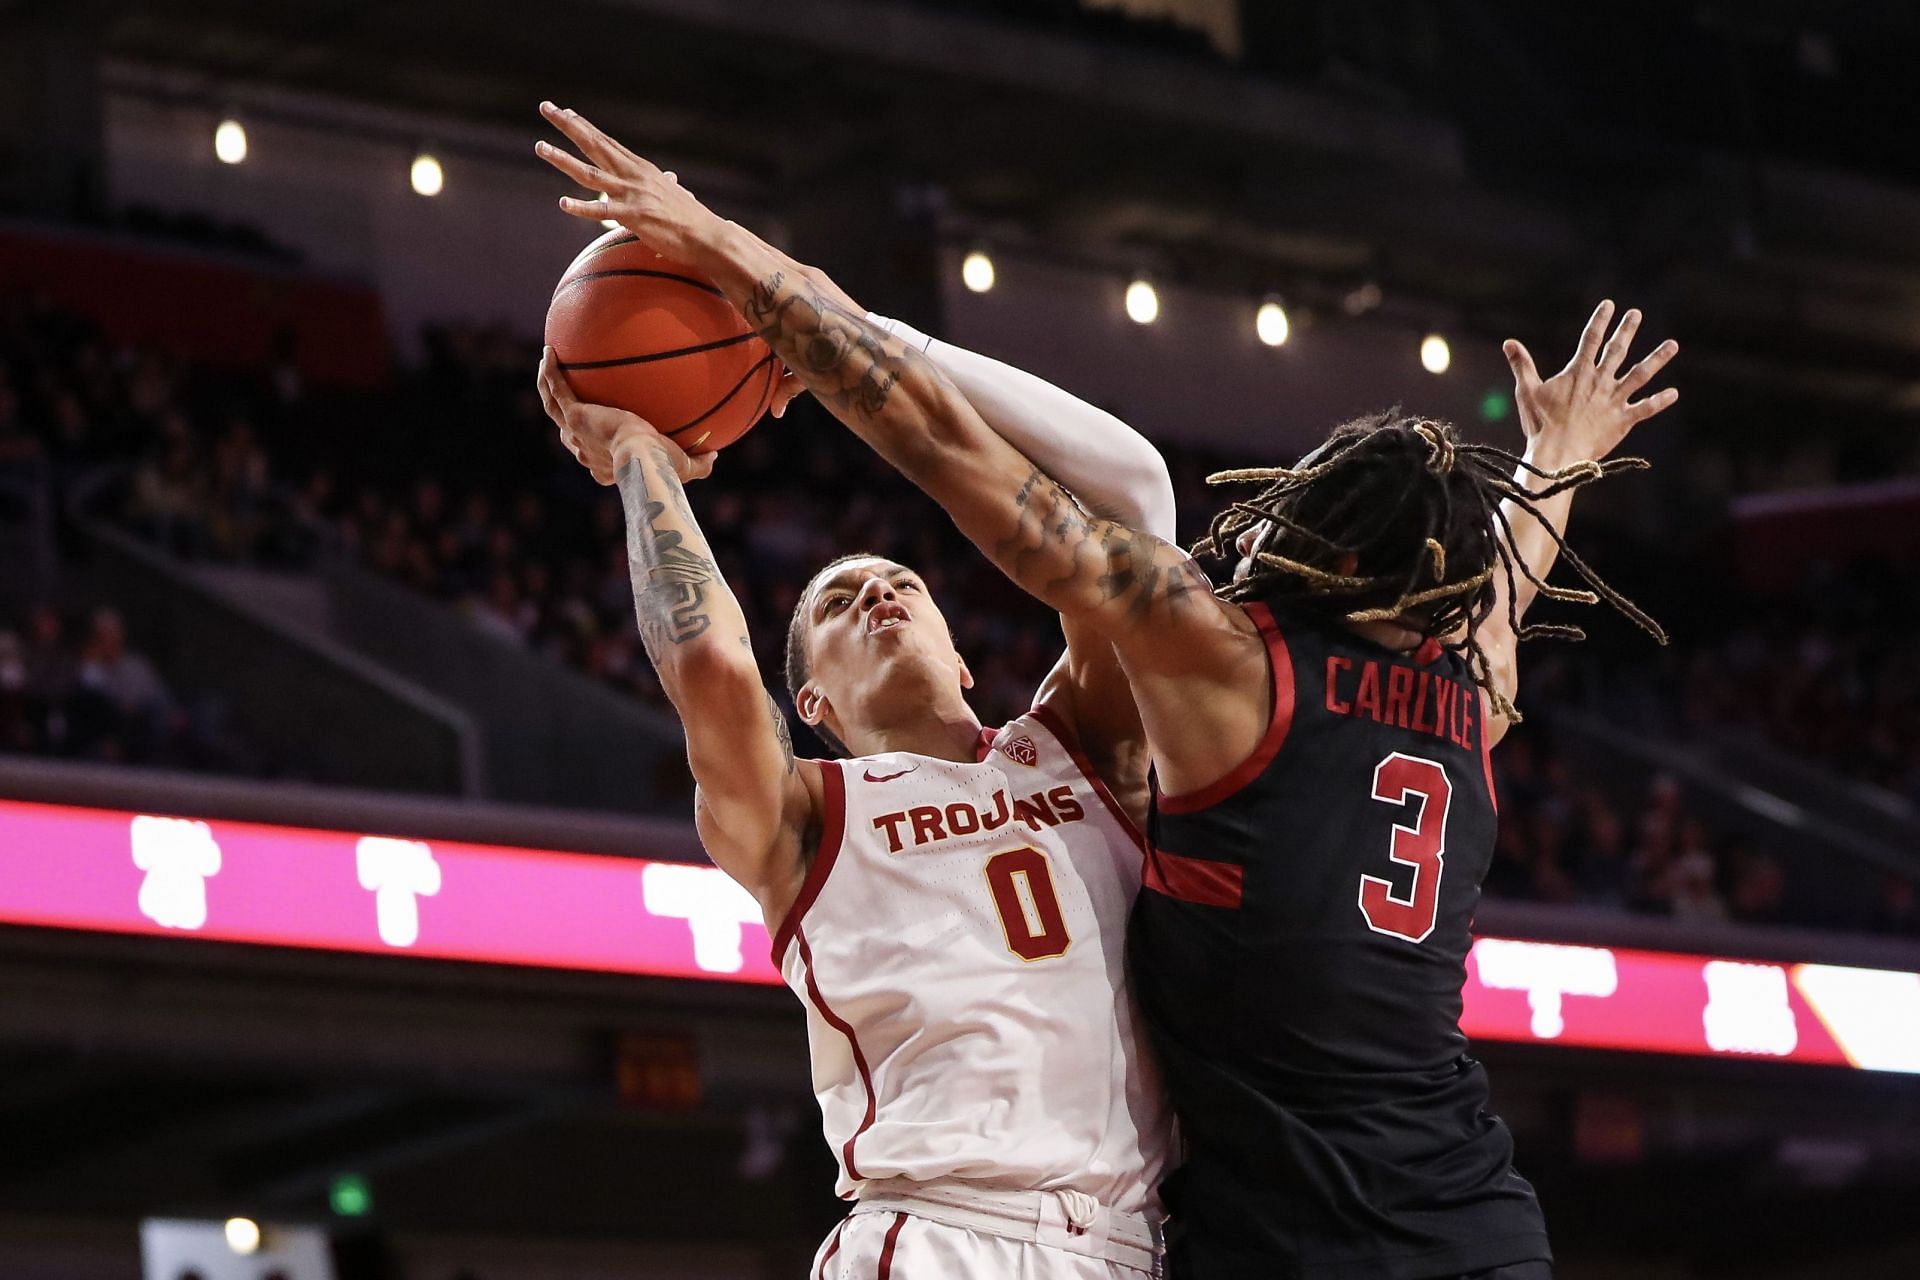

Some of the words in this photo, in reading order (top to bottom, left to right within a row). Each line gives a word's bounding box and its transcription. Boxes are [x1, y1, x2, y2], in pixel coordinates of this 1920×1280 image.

[1324, 655, 1473, 750] CARLYLE
[873, 785, 1086, 854] TROJNS
[1358, 751, 1453, 944] 3
[984, 846, 1072, 962] 0
